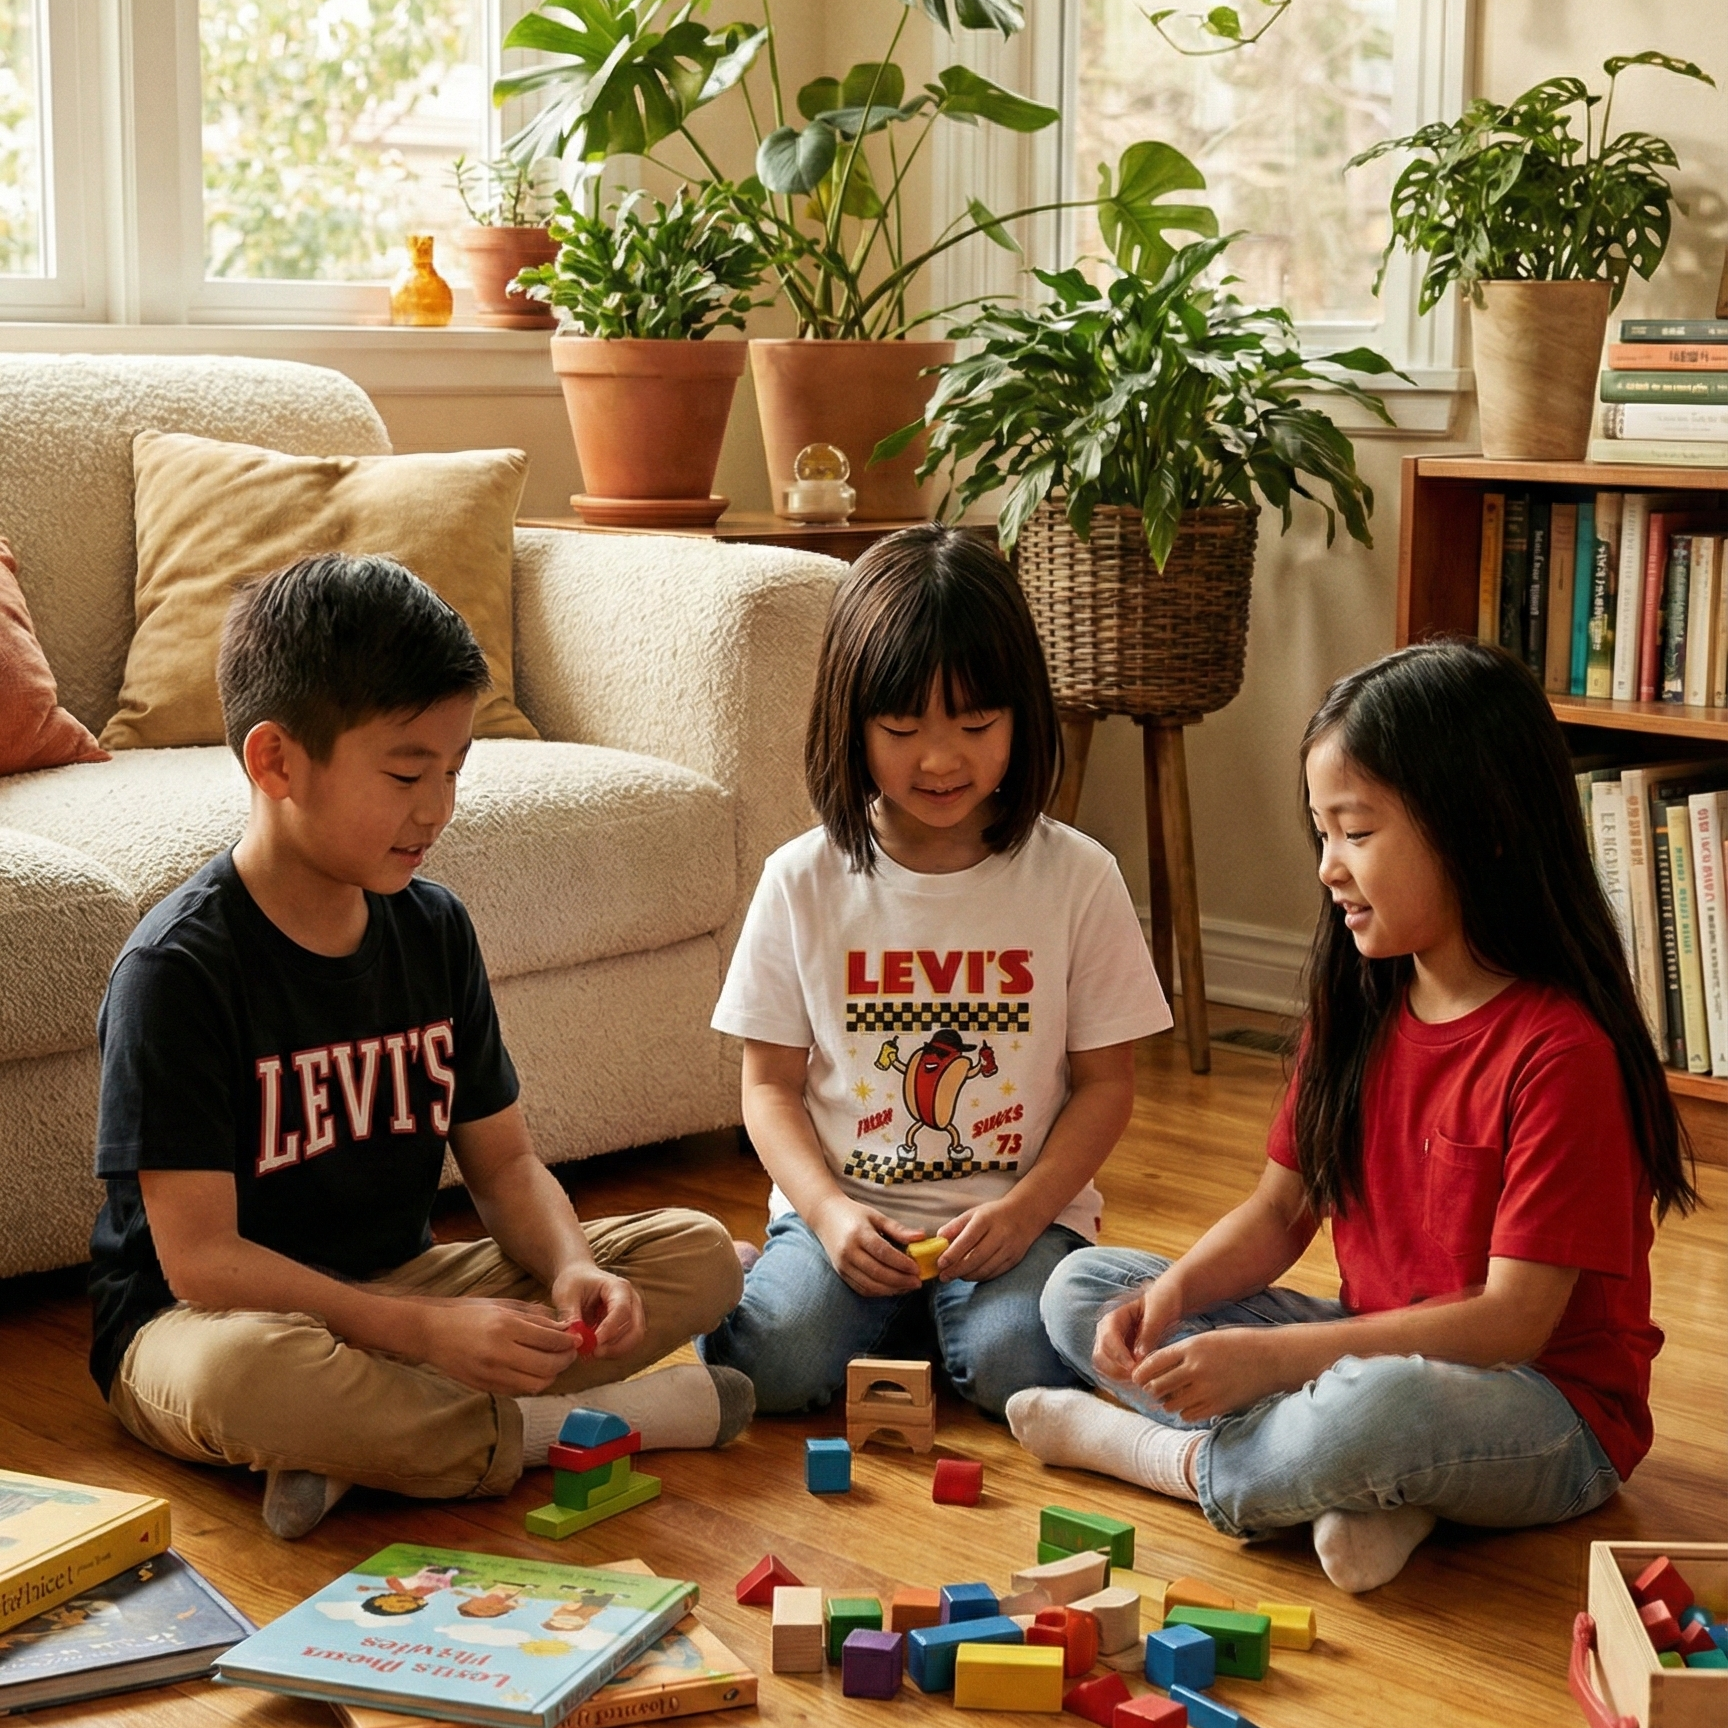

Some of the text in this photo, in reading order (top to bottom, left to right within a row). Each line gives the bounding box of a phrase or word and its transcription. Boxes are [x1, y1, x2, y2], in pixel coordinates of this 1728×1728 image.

[846, 949, 1034, 997] LEVI'S
[255, 1019, 456, 1177] LEVI'S
[996, 1133, 1023, 1155] 73
